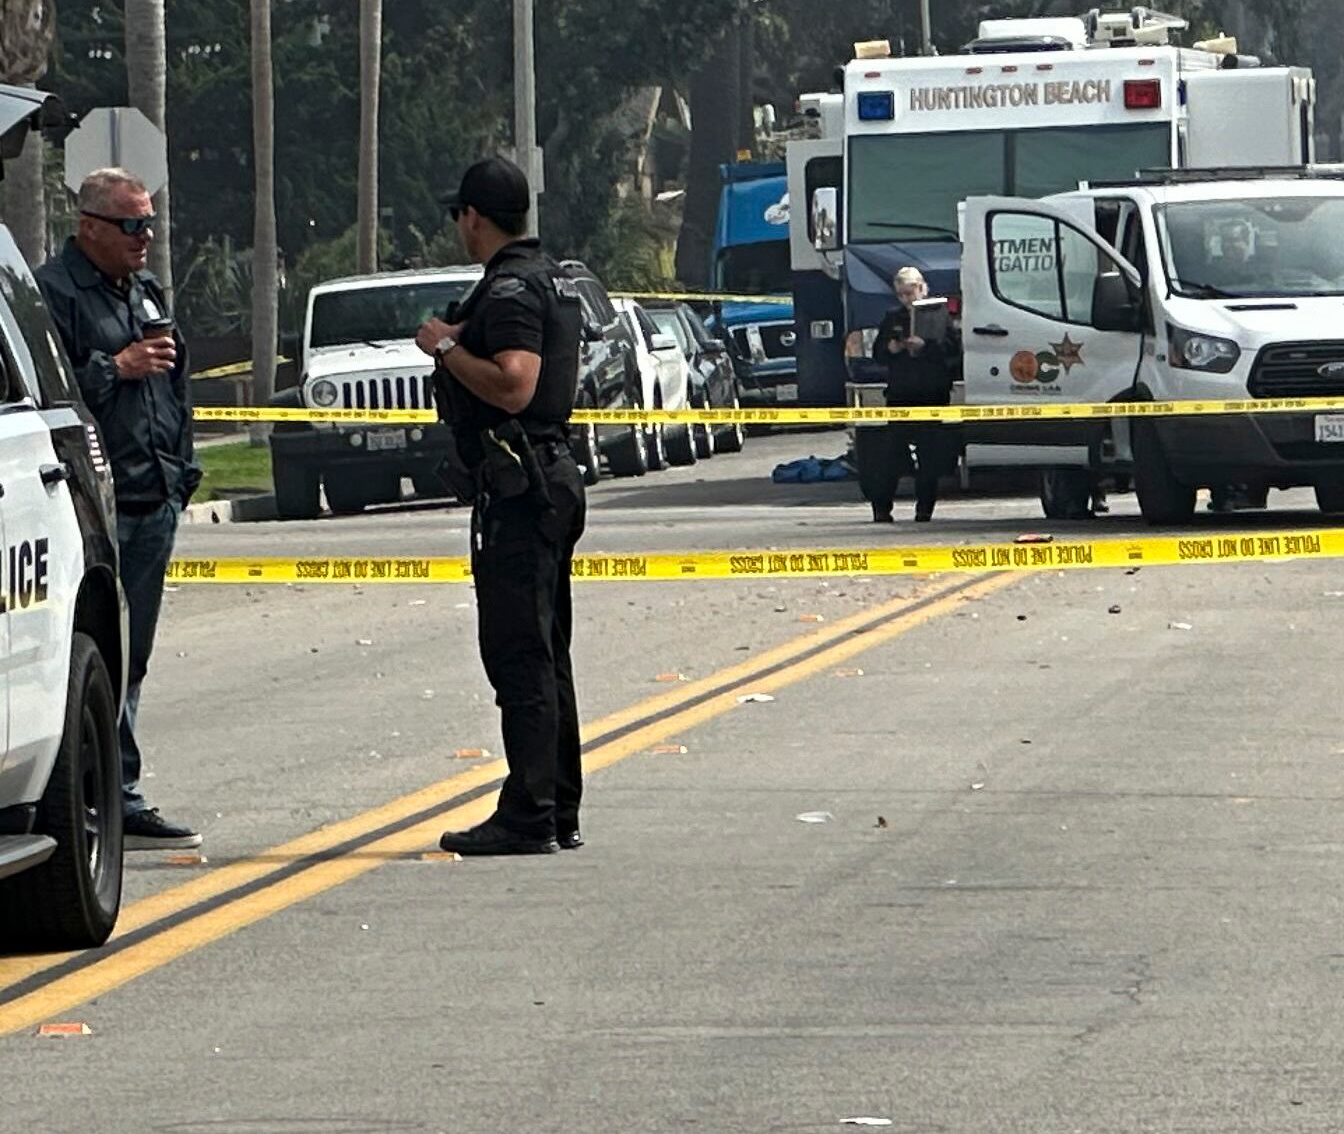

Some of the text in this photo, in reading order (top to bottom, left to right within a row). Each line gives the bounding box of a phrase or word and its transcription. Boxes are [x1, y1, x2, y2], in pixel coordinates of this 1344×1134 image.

[909, 79, 1111, 111] HUNTINGTON BEACH
[952, 545, 1092, 566] POLICE LINE DO NOT CROSS
[1179, 535, 1321, 558] POLICE LINE DO NOT CROSS
[296, 559, 430, 577] POLICE LINE DO NOT CROSS
[586, 557, 608, 575] LINE
[611, 557, 646, 575] POLICE
[729, 552, 868, 573] POLICE LINE DO NOT CROSS
